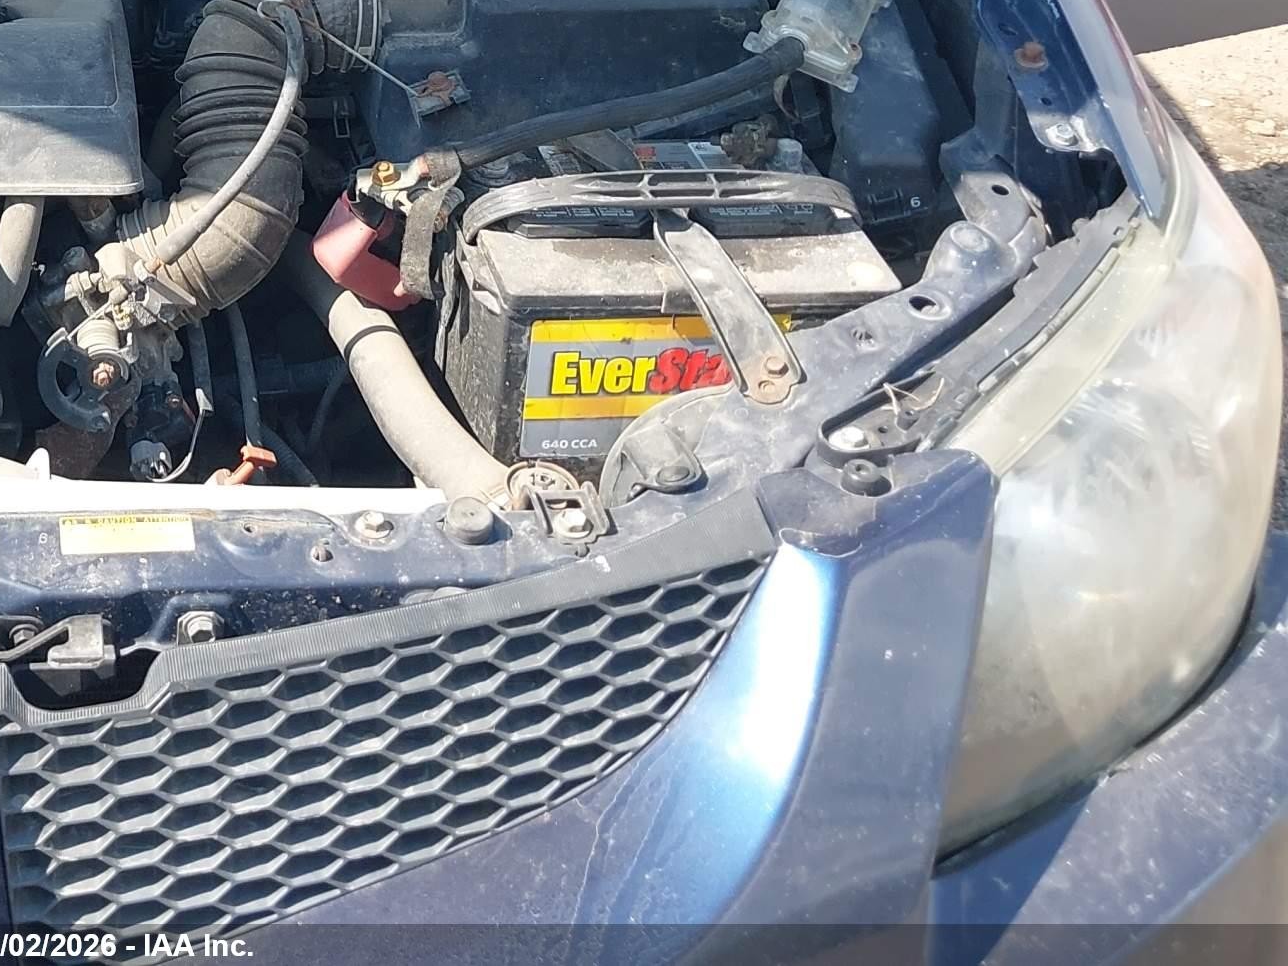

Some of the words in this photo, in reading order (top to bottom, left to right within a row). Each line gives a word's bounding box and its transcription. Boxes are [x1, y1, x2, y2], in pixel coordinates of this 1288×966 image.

[910, 196, 921, 208] 6
[549, 347, 733, 397] EverSta
[541, 438, 568, 450] 640
[571, 438, 598, 450] CCA
